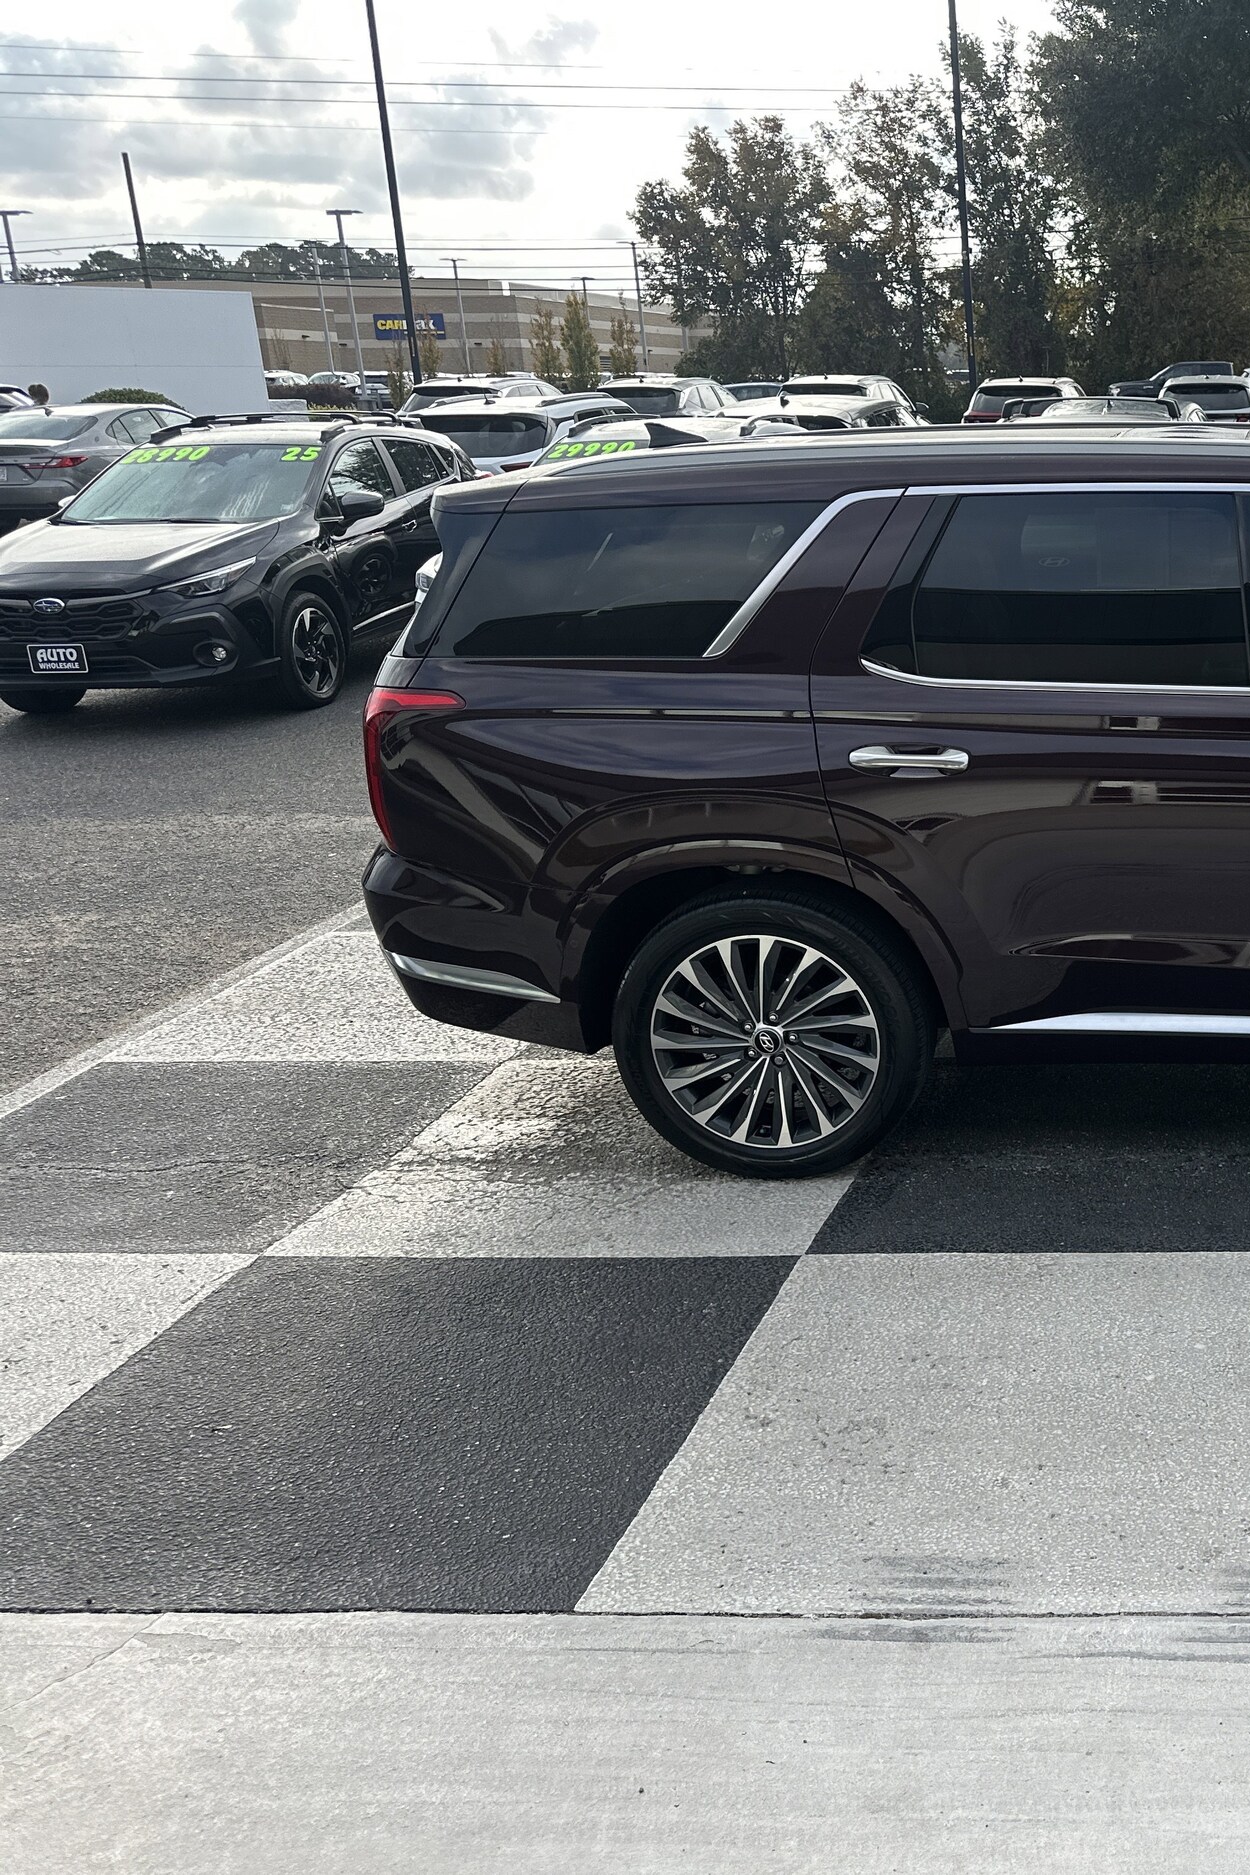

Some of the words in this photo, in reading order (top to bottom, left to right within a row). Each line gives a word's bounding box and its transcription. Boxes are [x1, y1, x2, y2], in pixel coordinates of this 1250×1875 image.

[120, 446, 210, 464] 28990
[281, 447, 321, 461] 25
[548, 441, 636, 459] 29990
[36, 648, 77, 662] AUTO
